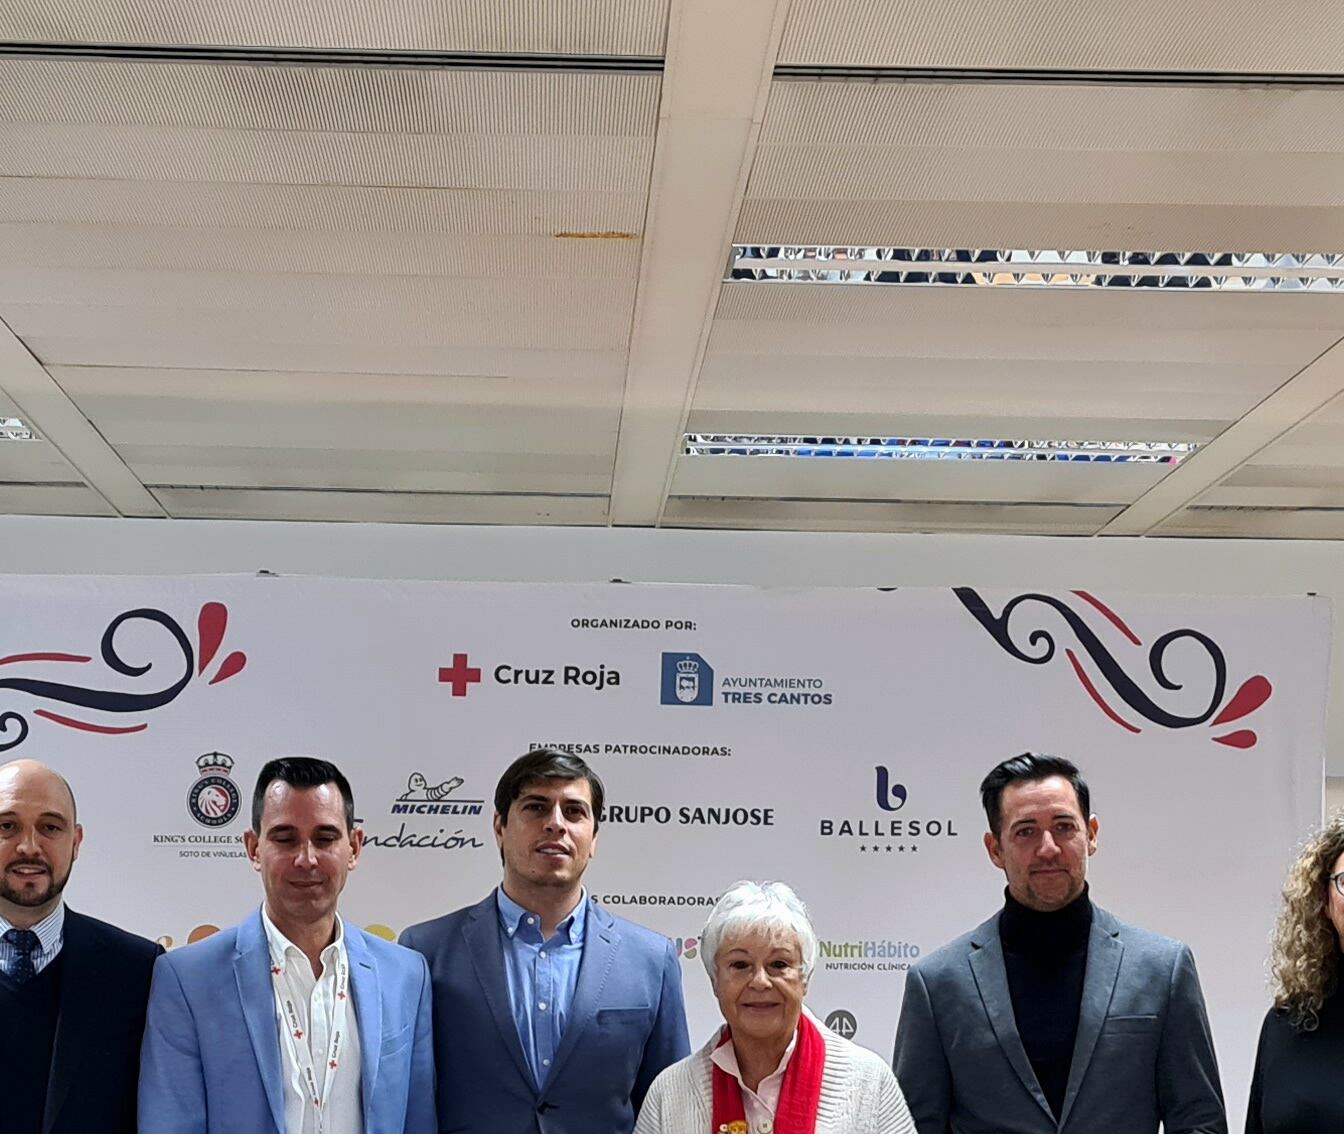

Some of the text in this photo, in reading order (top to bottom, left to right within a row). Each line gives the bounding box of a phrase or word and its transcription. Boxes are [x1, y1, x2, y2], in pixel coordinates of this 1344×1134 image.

[570, 618, 697, 631] ORGANIZADO POR:
[493, 664, 621, 690] Cruz Roja
[721, 677, 824, 690] AYUNTAMIENTO
[721, 691, 833, 706] TRES CANTOS
[604, 744, 732, 757] PATROCINADORAS:
[391, 804, 483, 815] MICHELIN
[678, 806, 775, 826] SANJOSE
[353, 819, 484, 850] ndación
[820, 820, 959, 837] BALLESOL
[153, 834, 186, 843] KING'S
[188, 835, 233, 844] COLLEGE
[179, 850, 200, 858] SOTO
[819, 939, 921, 958] NutriHábito
[825, 962, 875, 971] NUTRICIÓN
